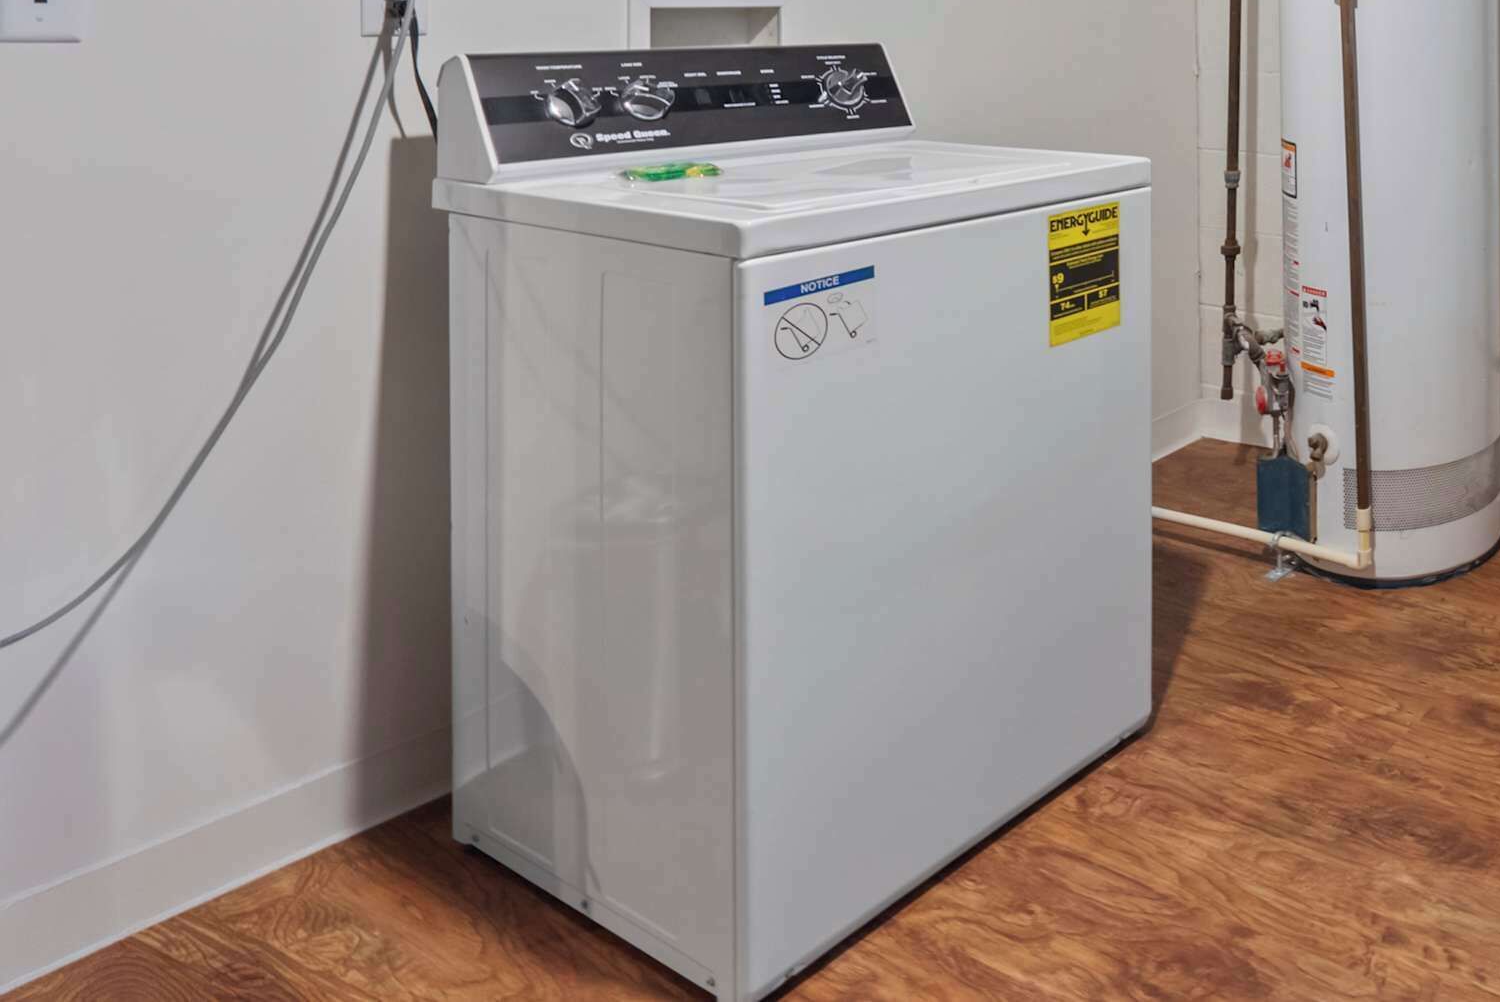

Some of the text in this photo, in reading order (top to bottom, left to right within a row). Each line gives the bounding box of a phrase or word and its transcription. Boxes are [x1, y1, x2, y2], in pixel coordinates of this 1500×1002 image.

[595, 131, 632, 143] Speed
[1050, 206, 1118, 233] ENERGYGUIDE
[800, 276, 840, 294] NOTICE
